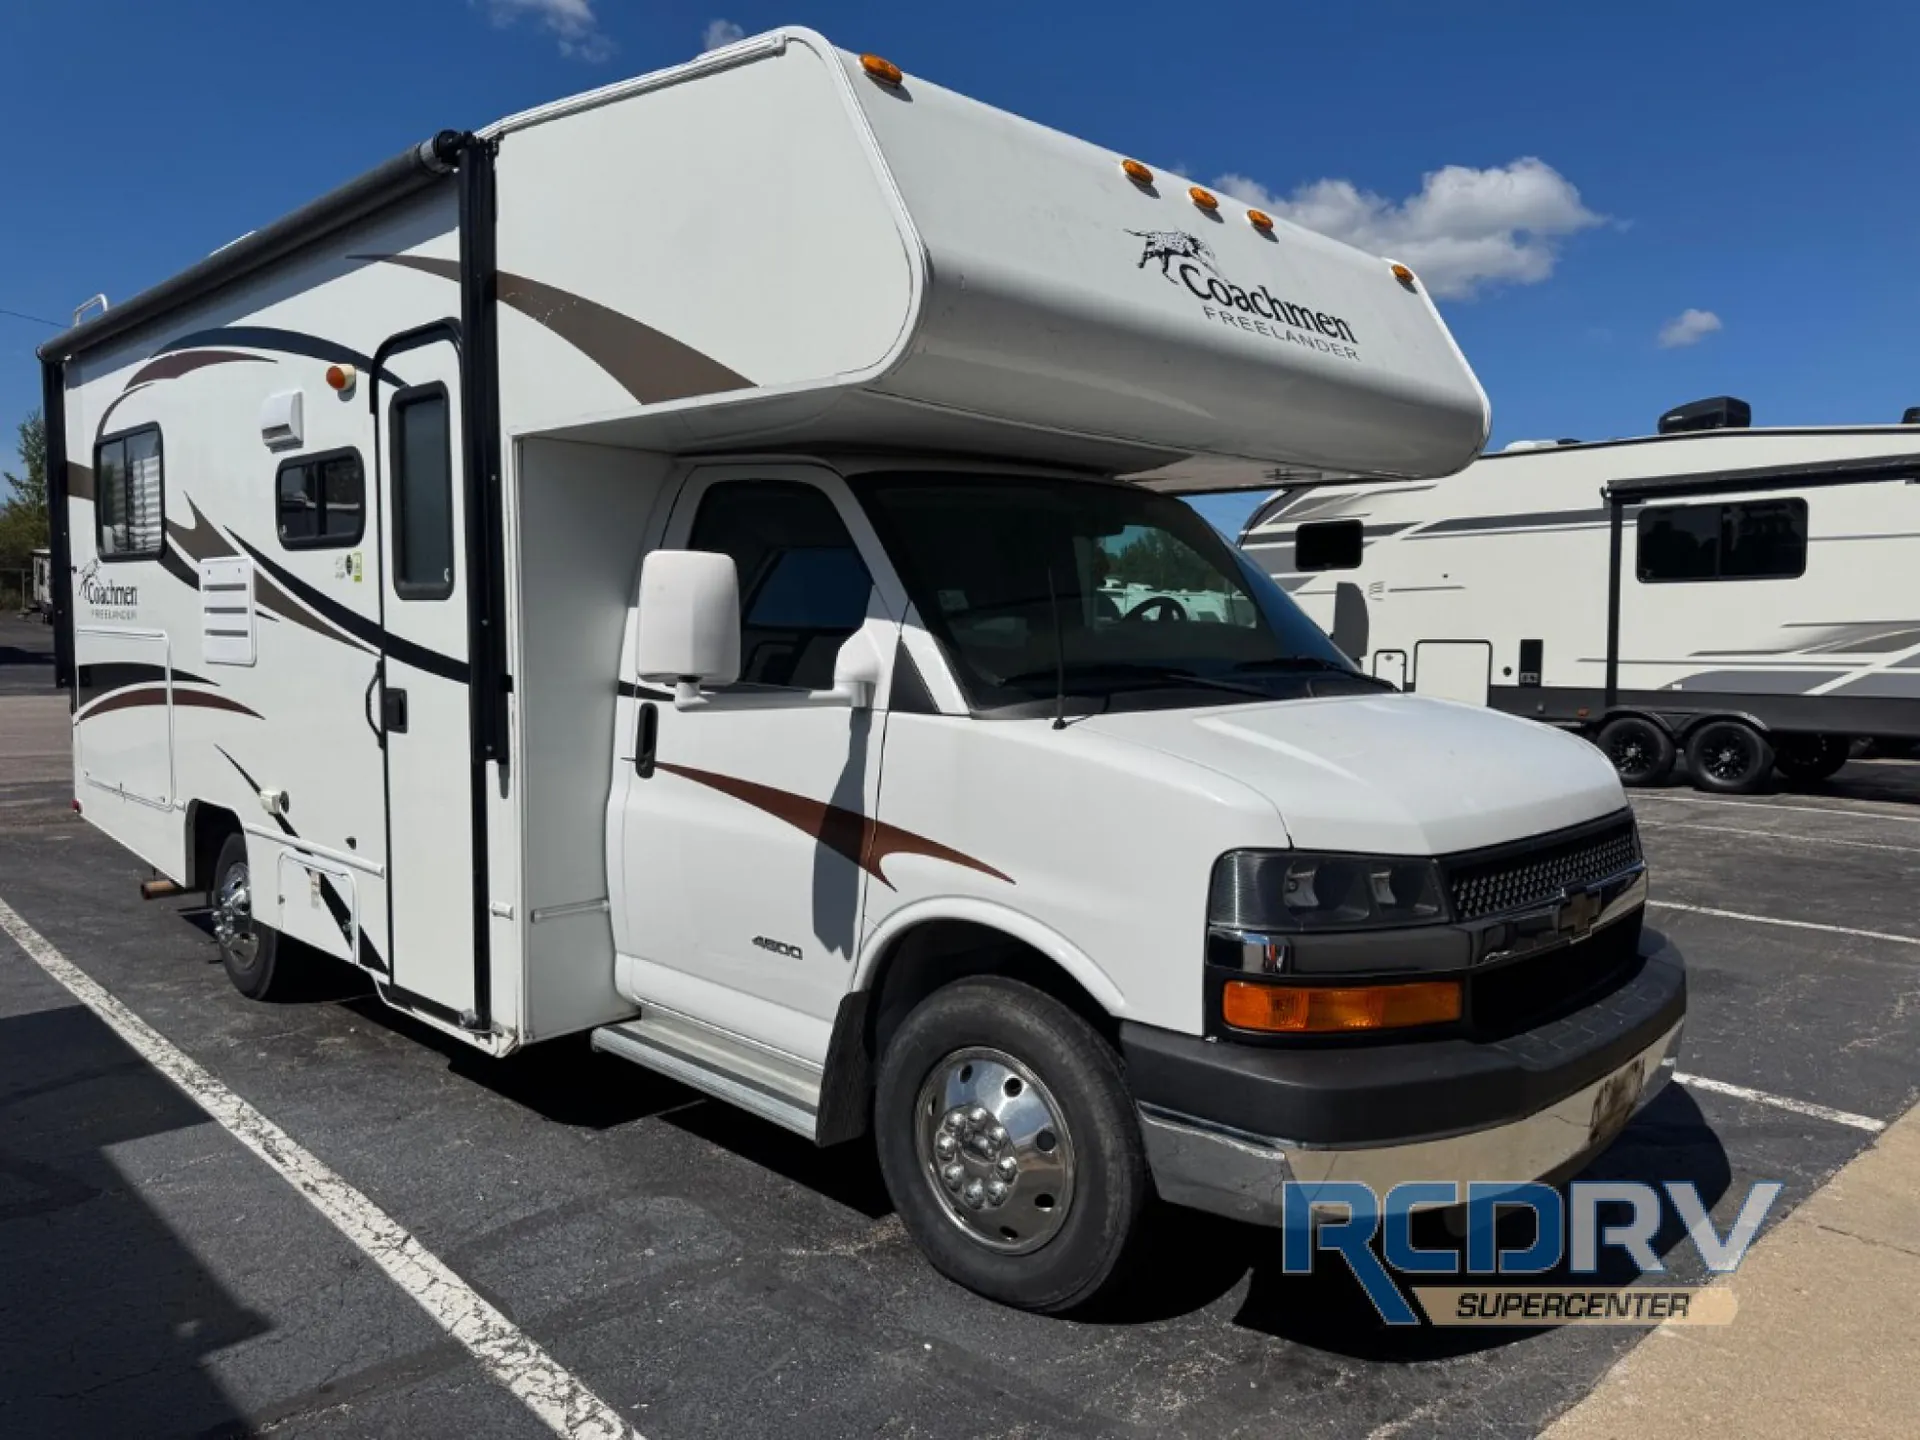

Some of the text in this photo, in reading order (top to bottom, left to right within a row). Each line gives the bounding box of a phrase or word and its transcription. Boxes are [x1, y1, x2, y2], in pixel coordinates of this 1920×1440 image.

[1179, 264, 1358, 343] Coachmen
[1203, 305, 1361, 361] FREELANDER
[87, 579, 137, 606] Coachmen
